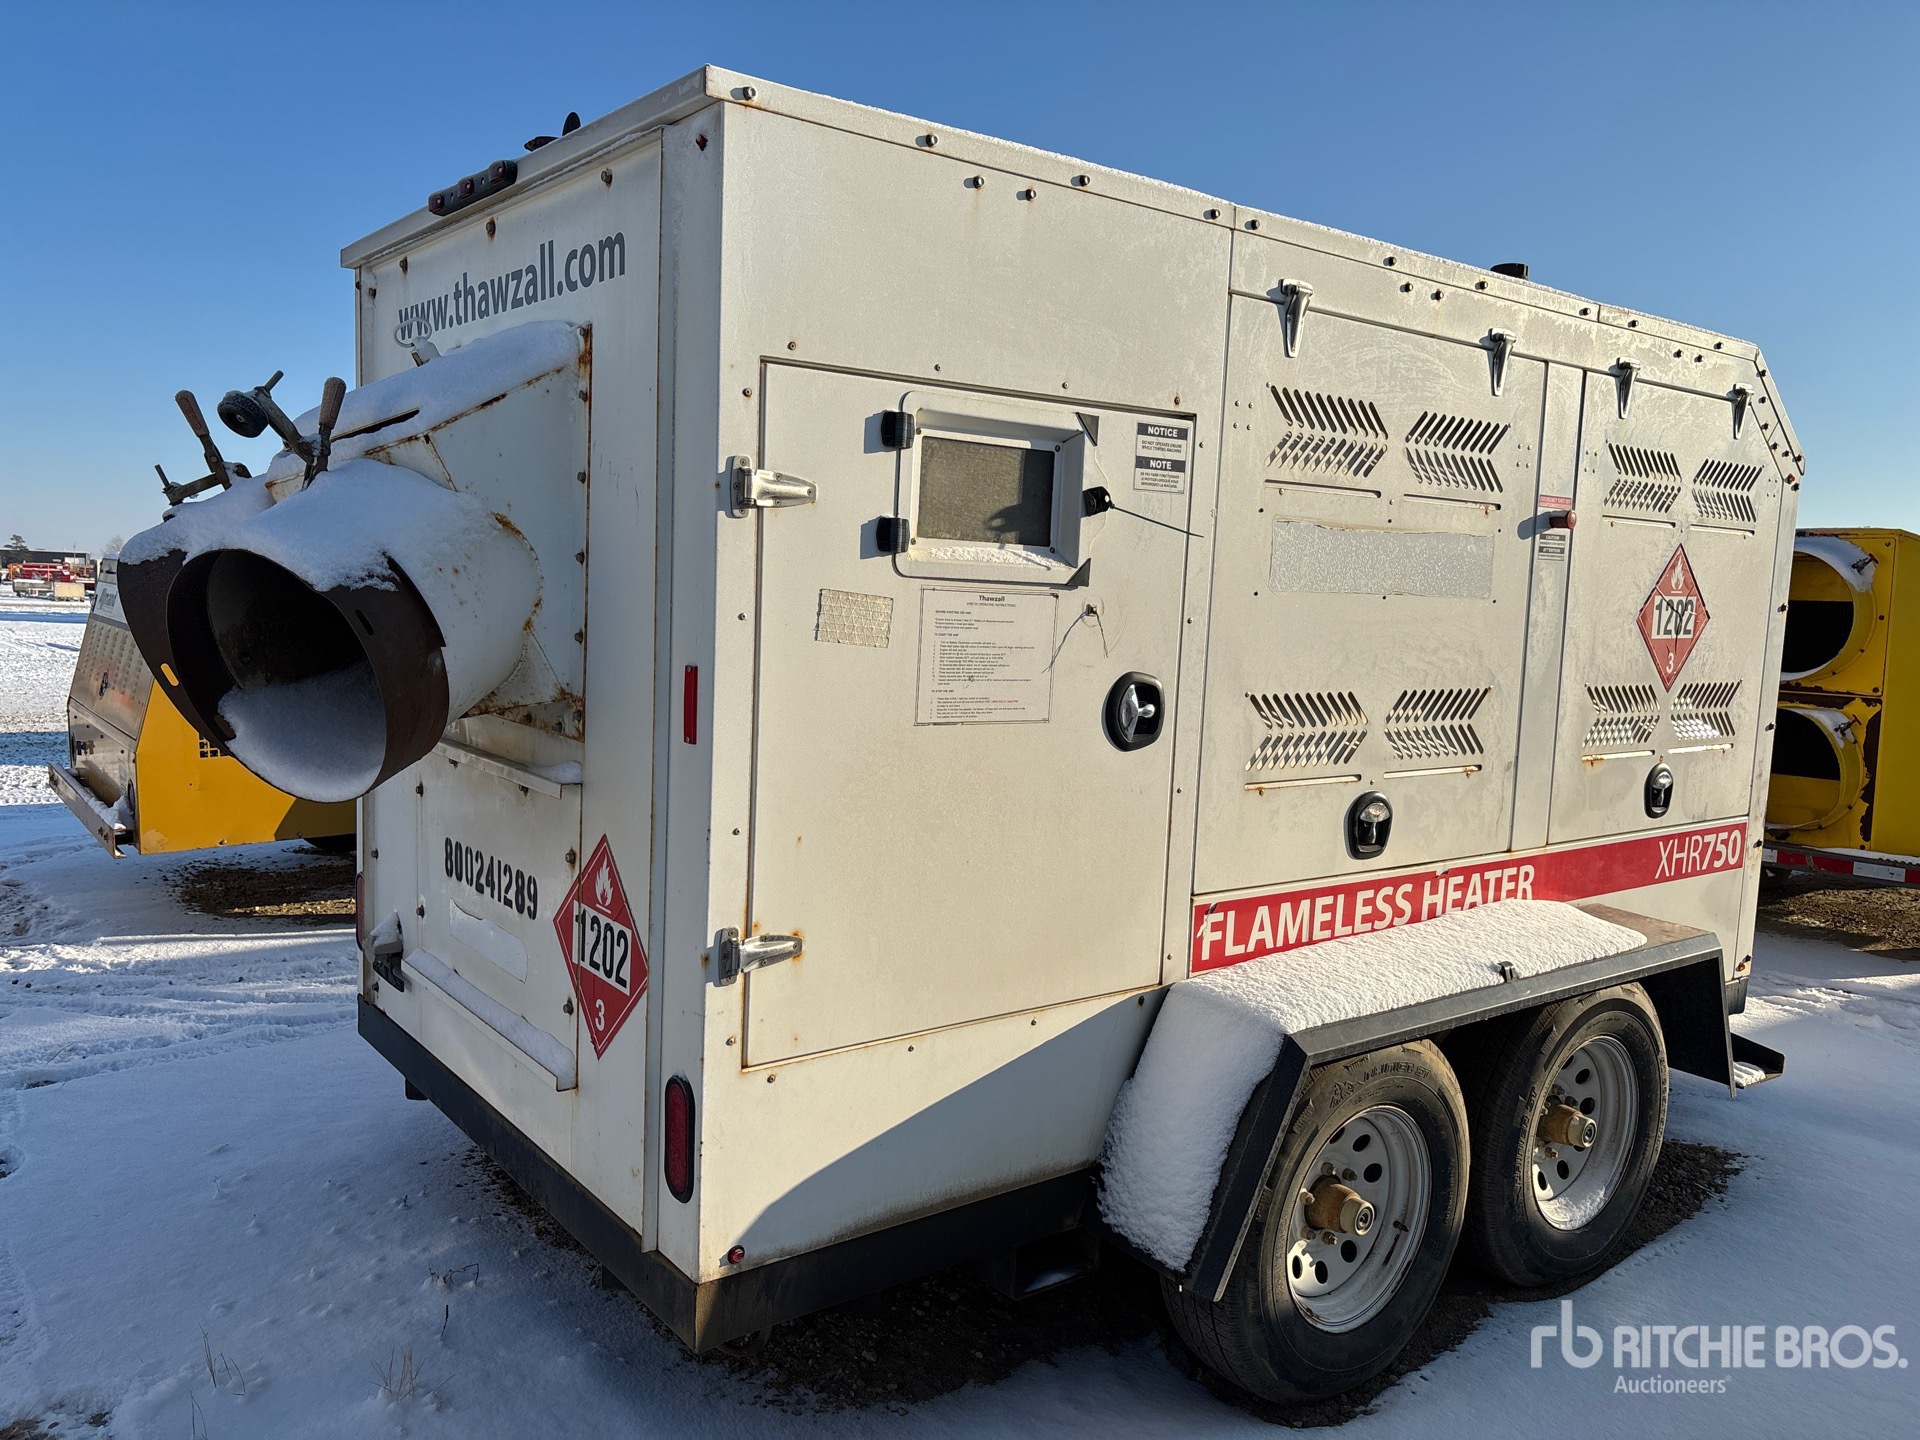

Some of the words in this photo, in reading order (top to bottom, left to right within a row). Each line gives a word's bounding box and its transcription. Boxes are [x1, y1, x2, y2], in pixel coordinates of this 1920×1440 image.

[398, 231, 626, 341] www.thawzall.com
[1147, 425, 1178, 437] NOTICE
[1150, 459, 1172, 470] NOTE
[1655, 598, 1694, 636] 1202
[1665, 652, 1674, 674] 3
[1654, 829, 1742, 880] XHR750
[444, 837, 538, 921] 800241289
[1199, 883, 1414, 961] FLAMELESS
[1421, 864, 1535, 921] HEATER
[574, 907, 629, 989] 1202
[595, 998, 606, 1032] 3
